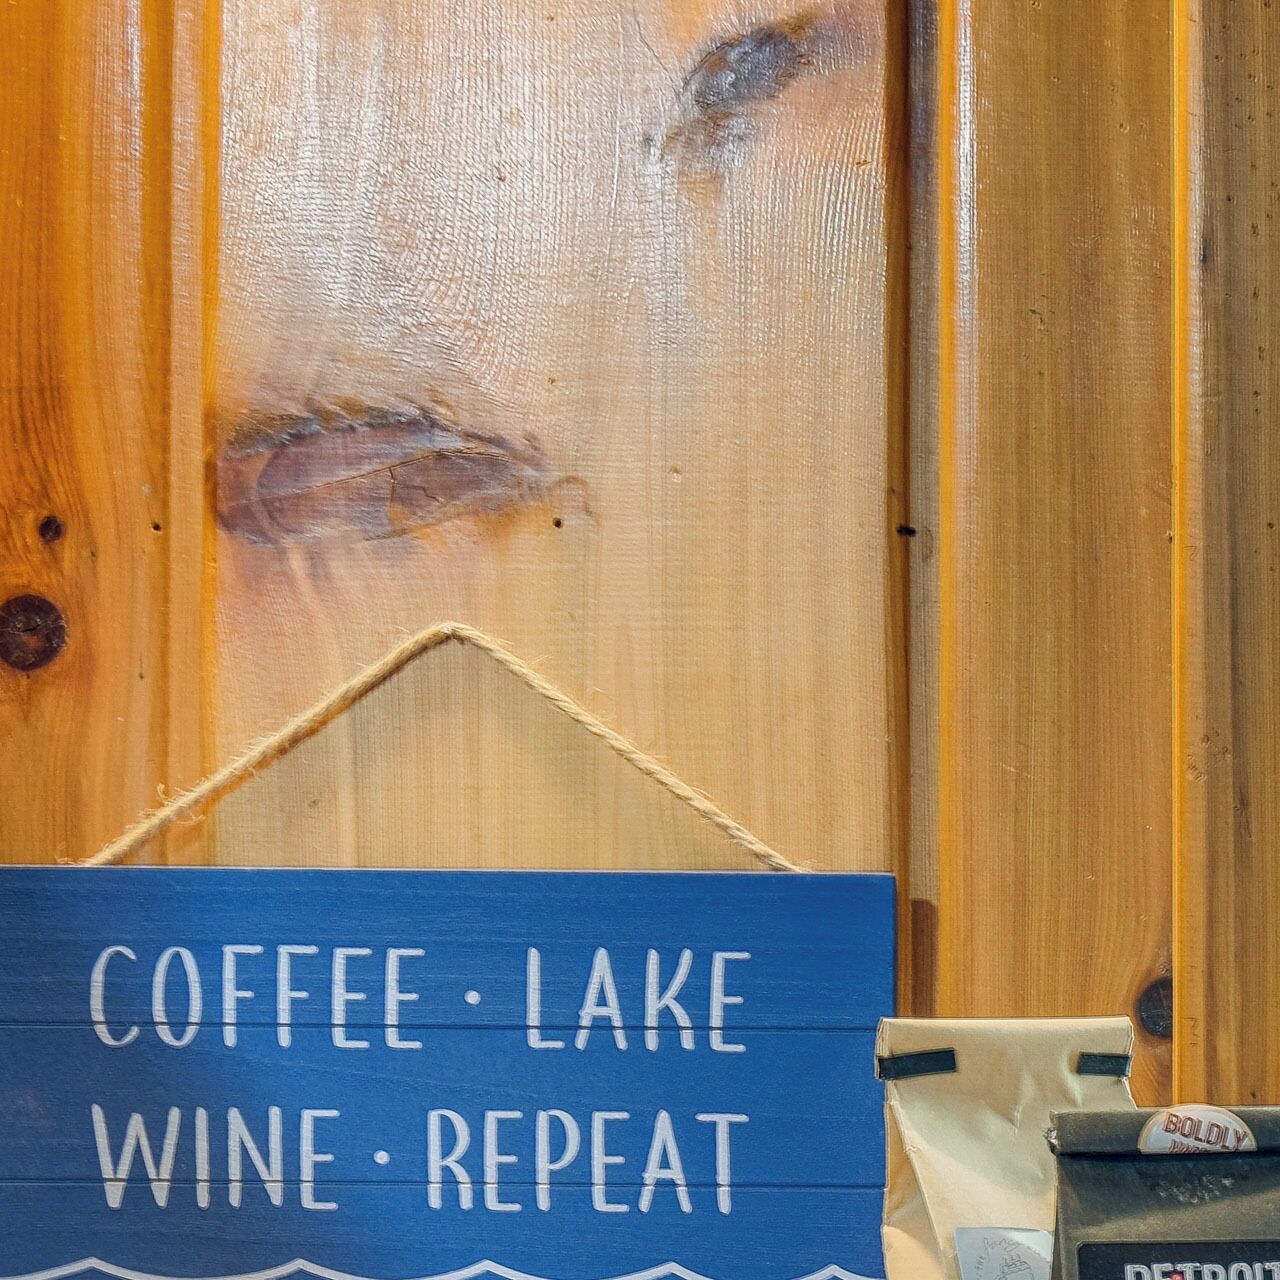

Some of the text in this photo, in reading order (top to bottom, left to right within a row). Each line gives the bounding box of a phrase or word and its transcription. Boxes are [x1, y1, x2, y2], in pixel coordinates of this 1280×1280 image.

[89, 945, 752, 1053] COFFEE LAKE
[91, 1104, 749, 1215] WINE REPEAT
[1163, 1111, 1249, 1153] BOLDLY
